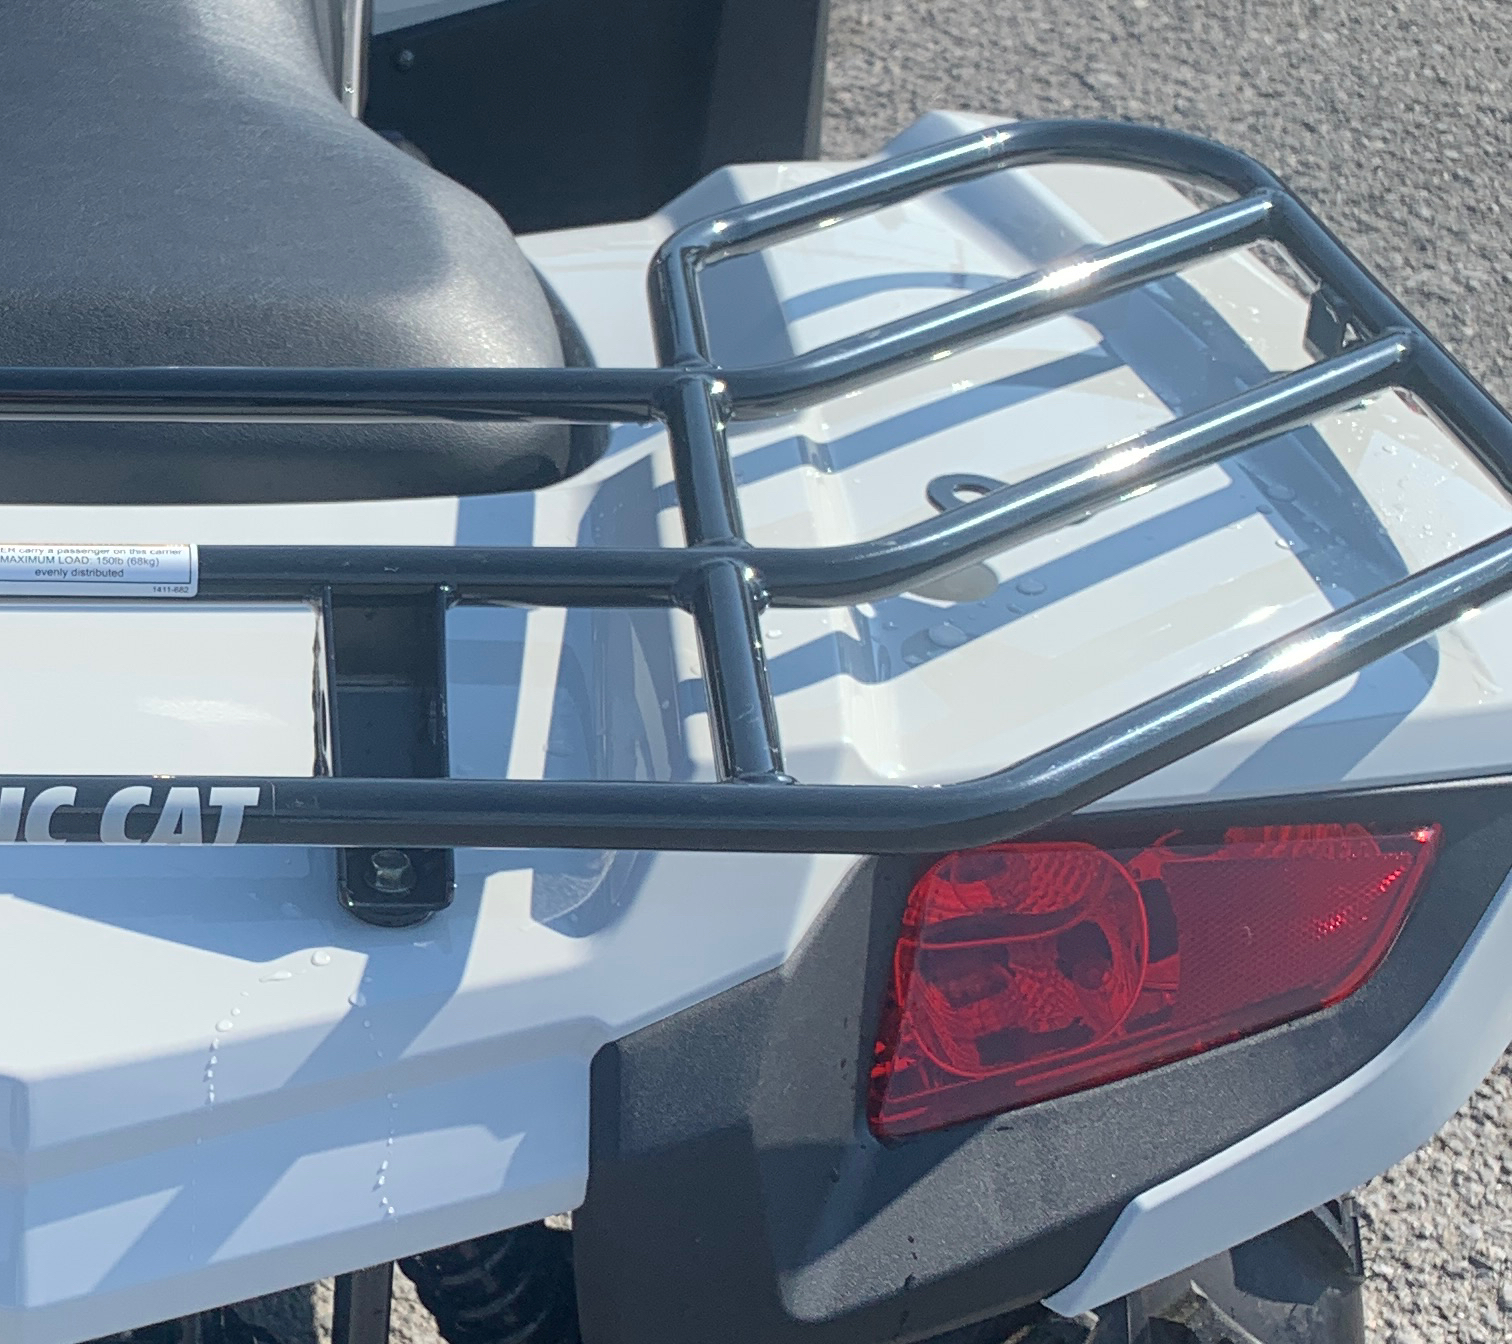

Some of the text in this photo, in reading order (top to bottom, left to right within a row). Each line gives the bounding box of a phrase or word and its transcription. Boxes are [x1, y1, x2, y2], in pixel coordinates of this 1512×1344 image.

[0, 555, 55, 564] MAXIMUM
[97, 556, 124, 565] 150lb
[126, 556, 160, 568] (68kg)
[34, 569, 124, 578] evenly distributed
[152, 586, 189, 594] 1411-682
[98, 785, 261, 846] CAT
